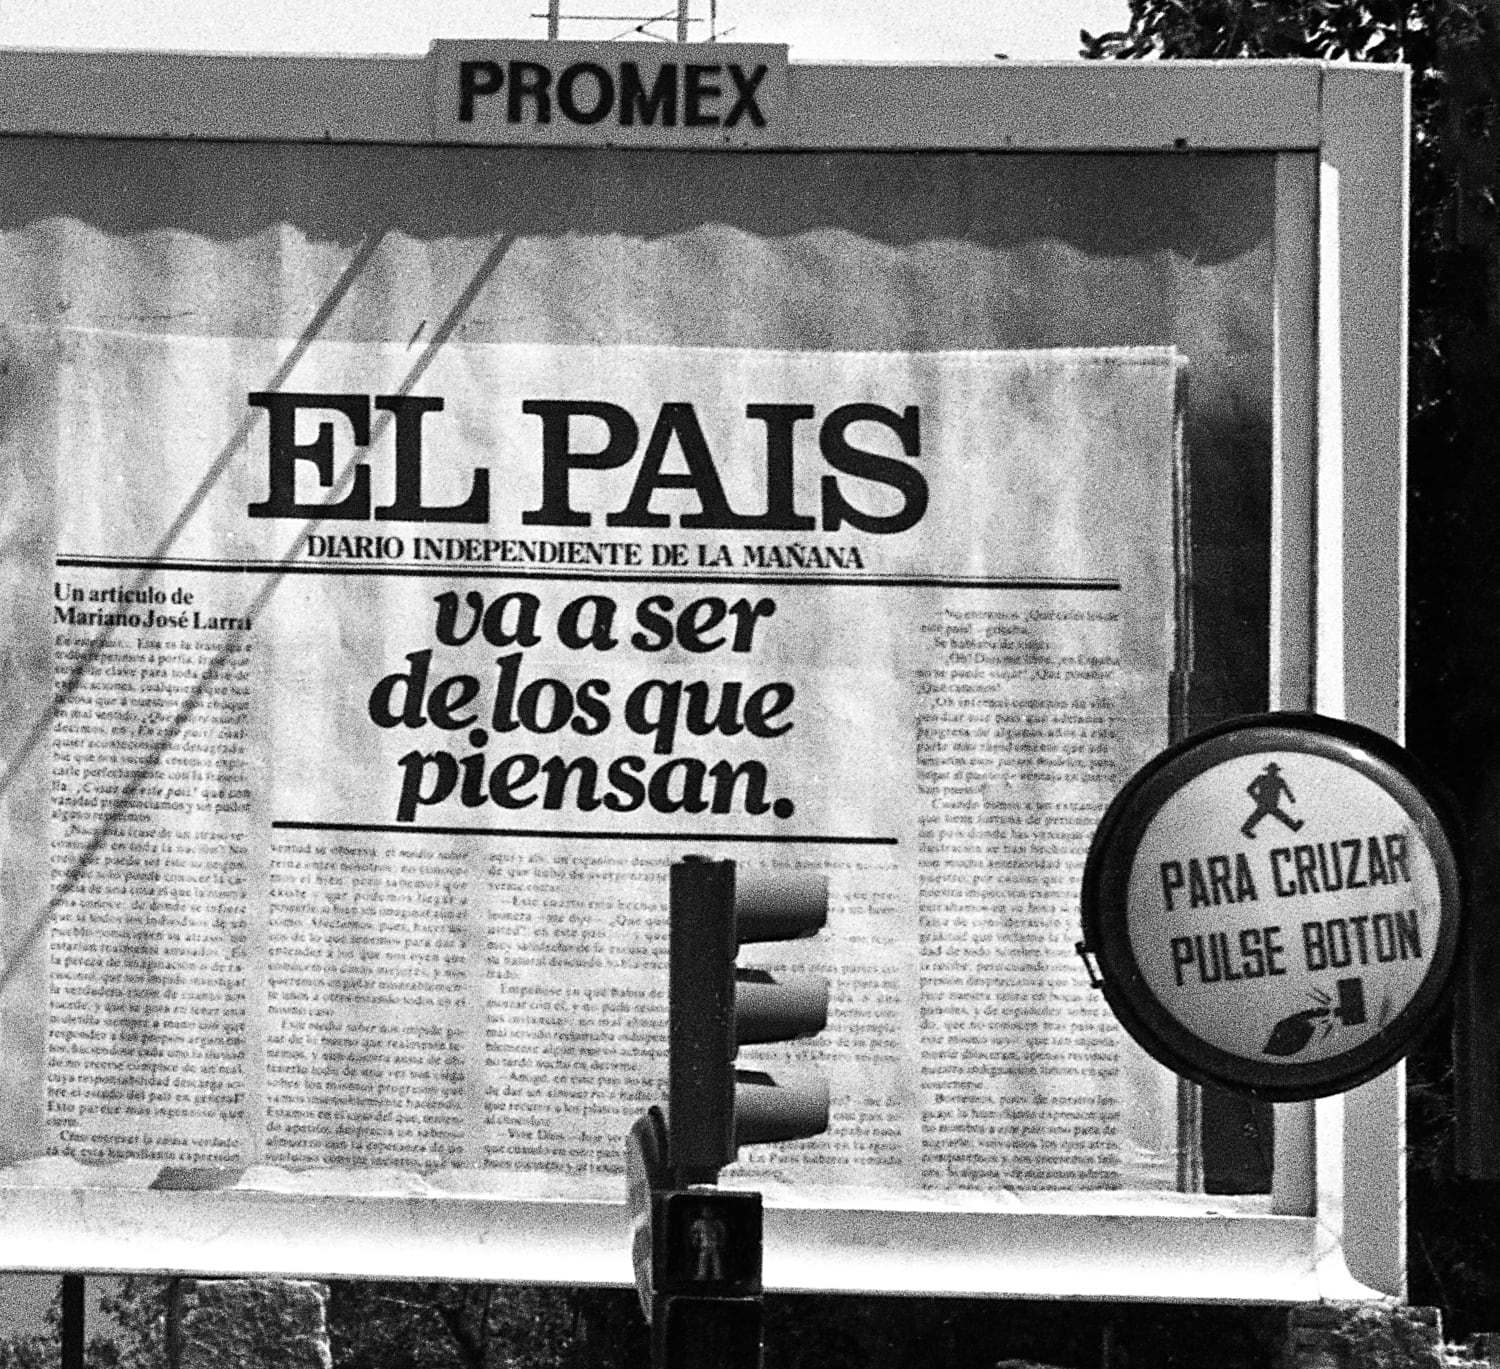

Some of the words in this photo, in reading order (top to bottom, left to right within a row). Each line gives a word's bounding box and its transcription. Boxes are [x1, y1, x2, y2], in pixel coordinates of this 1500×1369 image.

[457, 60, 769, 129] PROMEX
[248, 391, 490, 524] EL
[522, 400, 929, 534] PAIS
[307, 535, 404, 559] DIARIO
[412, 537, 642, 566] INDEPENDIENTE
[651, 542, 689, 566] DE
[697, 544, 734, 567] LA
[742, 544, 866, 569] MAÑANA
[54, 582, 84, 602] Un
[170, 588, 194, 605] de
[54, 606, 141, 627] Mariano
[142, 609, 188, 629] José
[193, 611, 252, 631] Larra
[434, 591, 540, 647] va
[557, 595, 618, 651] a
[631, 595, 777, 653] ser
[368, 648, 480, 731] de
[492, 652, 611, 736] los
[625, 679, 796, 755] que
[397, 728, 795, 822] piensan.
[1159, 852, 1258, 912] PARA
[1270, 833, 1411, 898] CRUZAR
[1169, 926, 1287, 987] PULSE
[1302, 910, 1423, 972] BOTON
